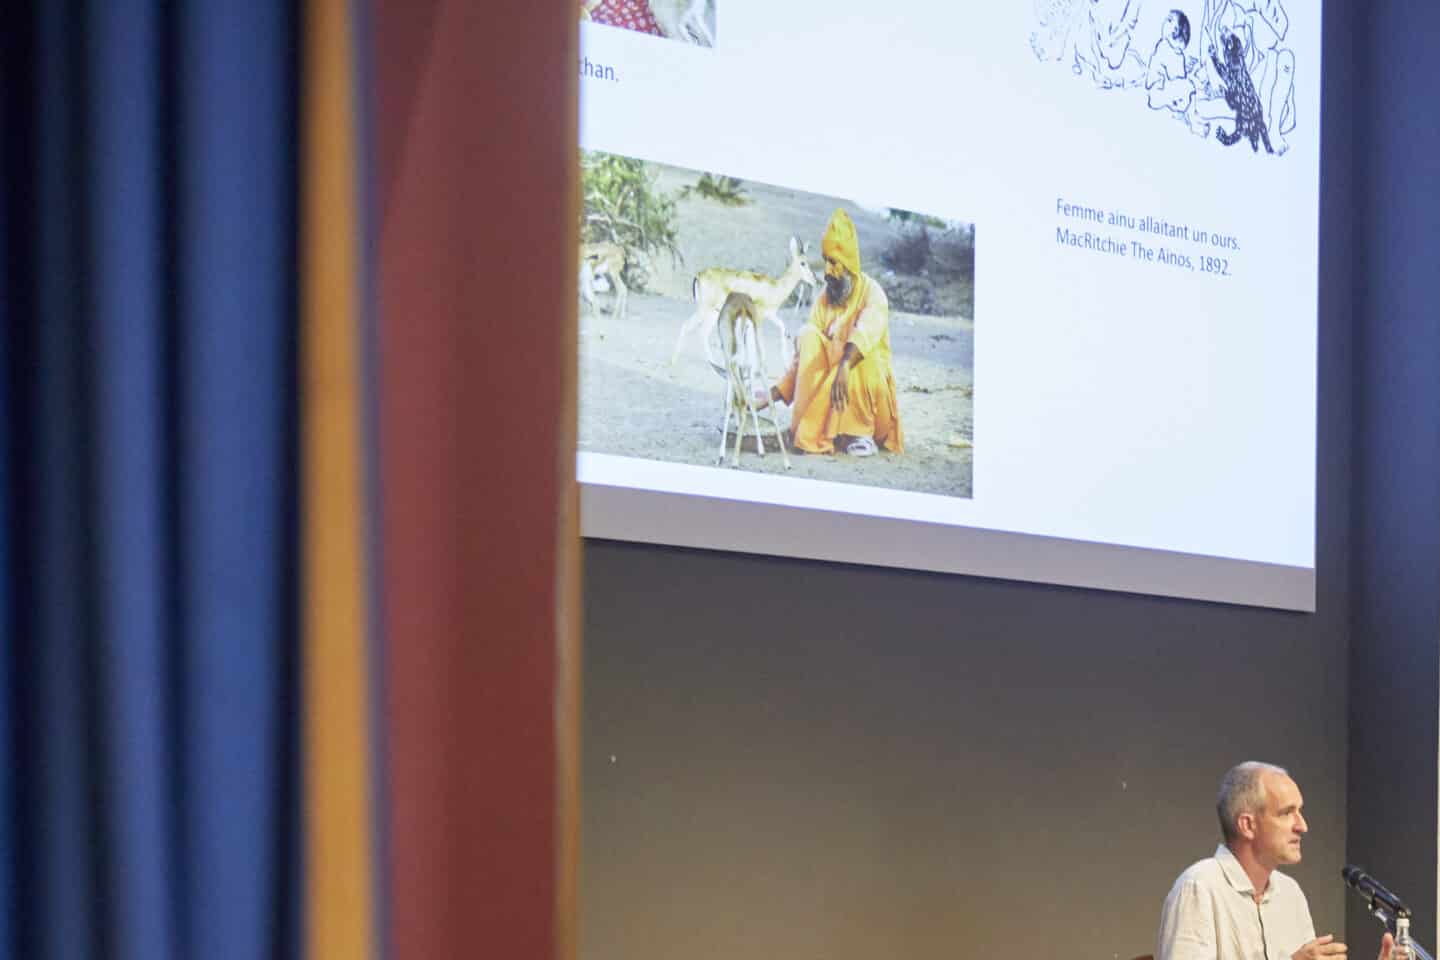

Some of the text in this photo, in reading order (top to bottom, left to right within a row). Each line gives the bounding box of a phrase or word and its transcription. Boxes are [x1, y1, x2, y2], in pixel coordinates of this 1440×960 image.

[1056, 198, 1240, 250] Femme ainu allaitant un ours.
[1056, 227, 1127, 256] MacRitchie
[1131, 241, 1154, 261] The
[1157, 248, 1195, 271] Ainos,
